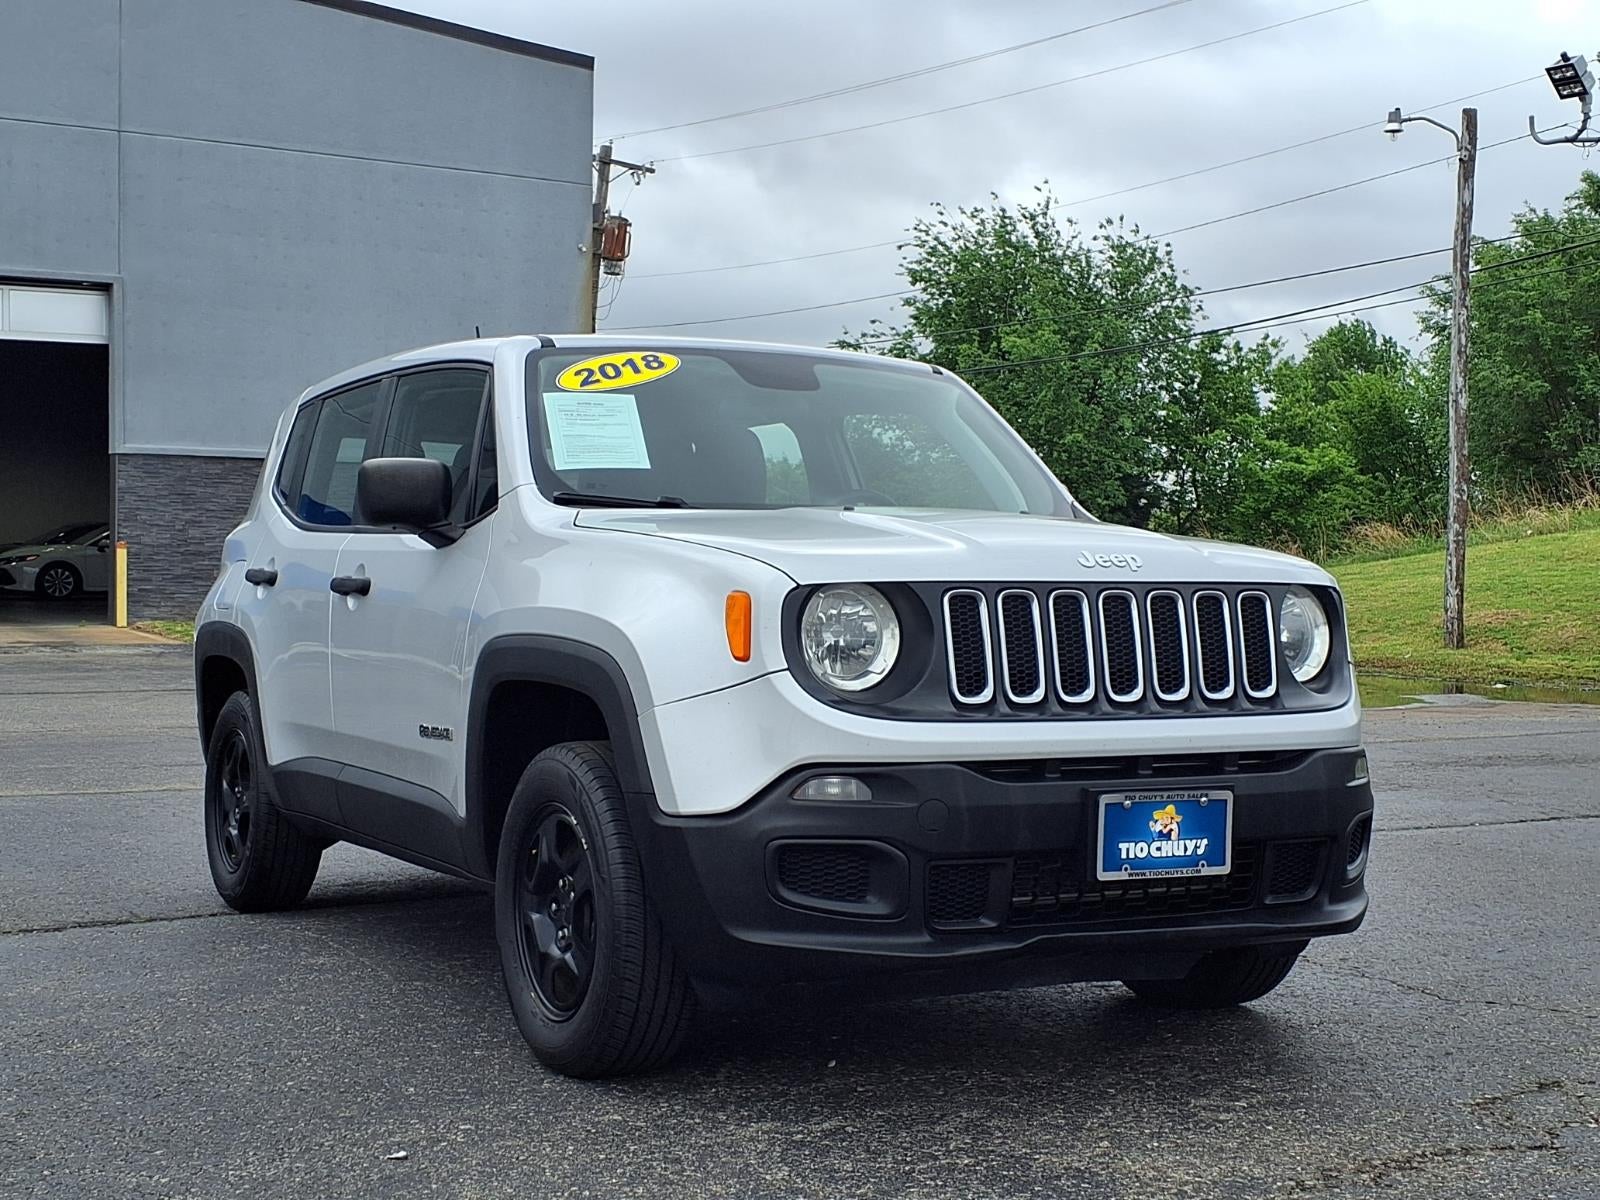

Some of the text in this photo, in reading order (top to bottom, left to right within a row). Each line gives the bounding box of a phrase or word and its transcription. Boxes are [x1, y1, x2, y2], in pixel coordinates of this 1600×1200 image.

[574, 354, 666, 388] 2018
[1077, 550, 1143, 572] Jeep
[1138, 793, 1164, 801] CHUY'S
[1127, 868, 1202, 878] WWW.TIOCHUYS.COM
